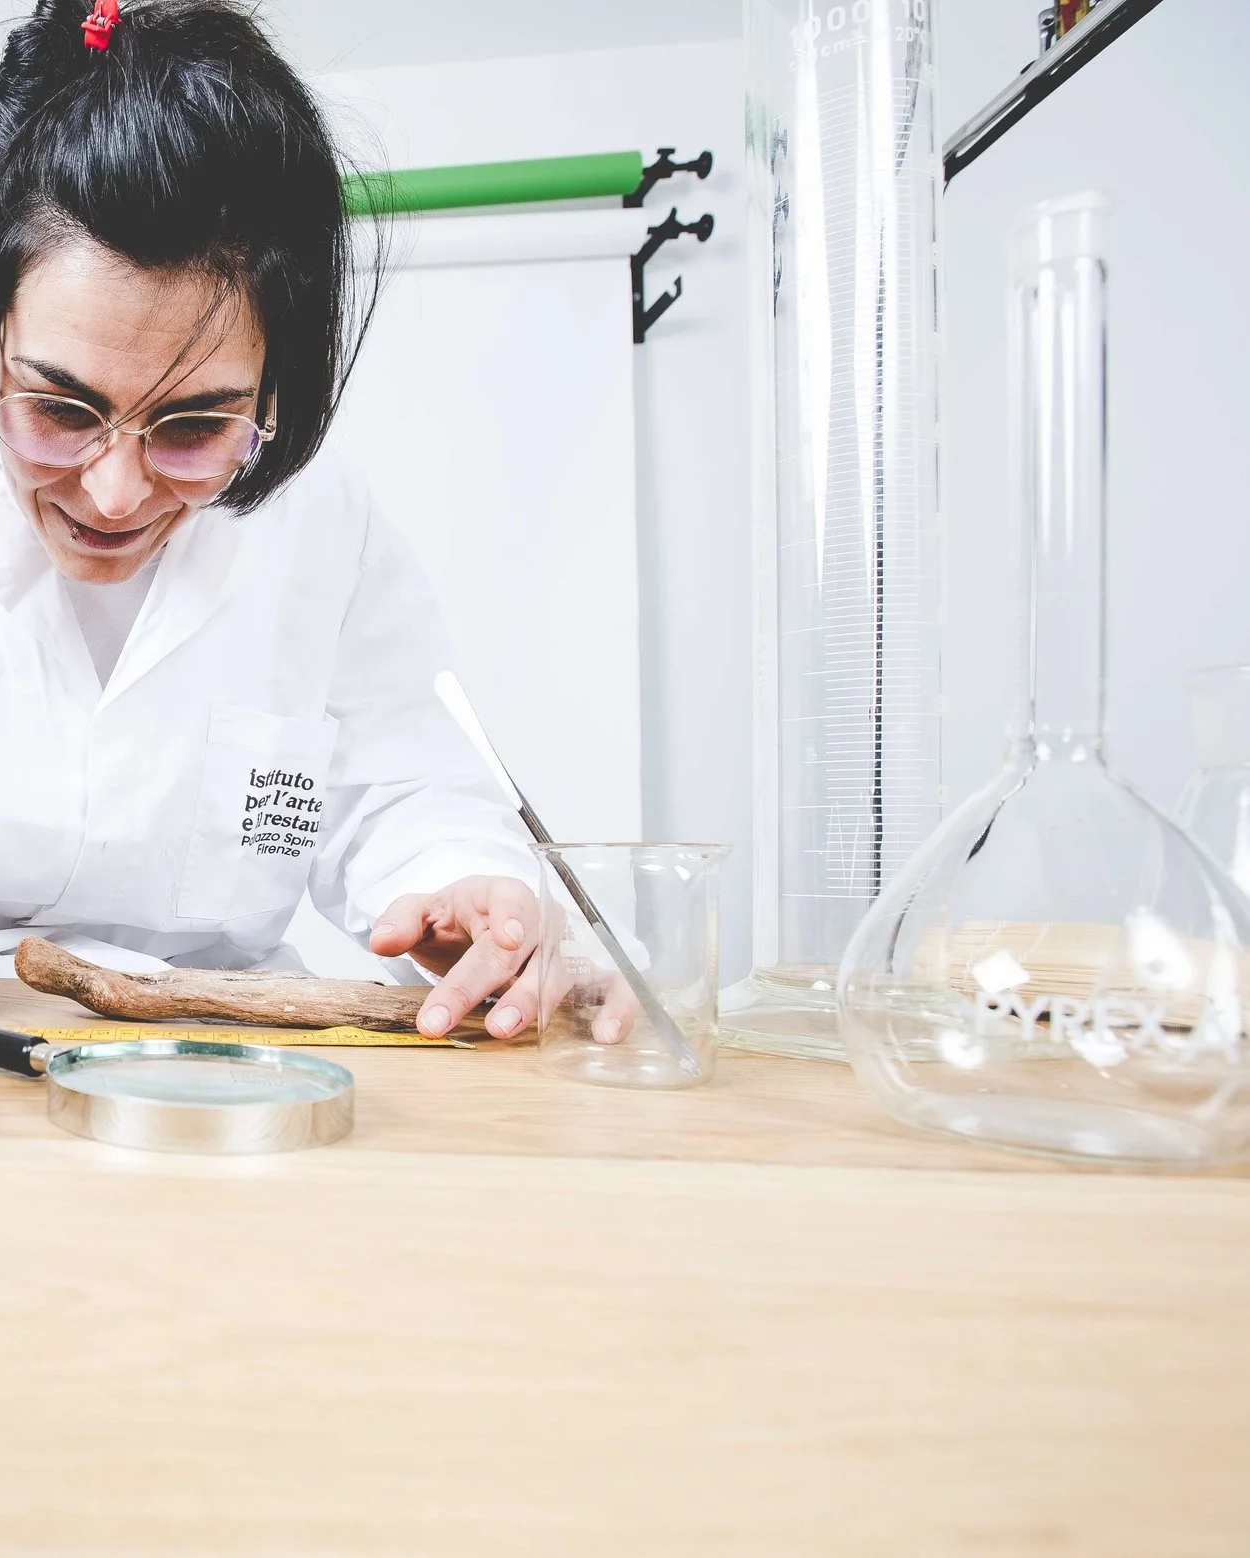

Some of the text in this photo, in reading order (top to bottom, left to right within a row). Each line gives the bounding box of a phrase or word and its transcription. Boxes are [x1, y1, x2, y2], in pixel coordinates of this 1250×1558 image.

[788, 0, 871, 48] 1000
[250, 768, 314, 791] istituto
[245, 794, 271, 812] per
[242, 818, 254, 831] e
[257, 843, 301, 858] Firenze
[975, 992, 1169, 1051] PYREX
